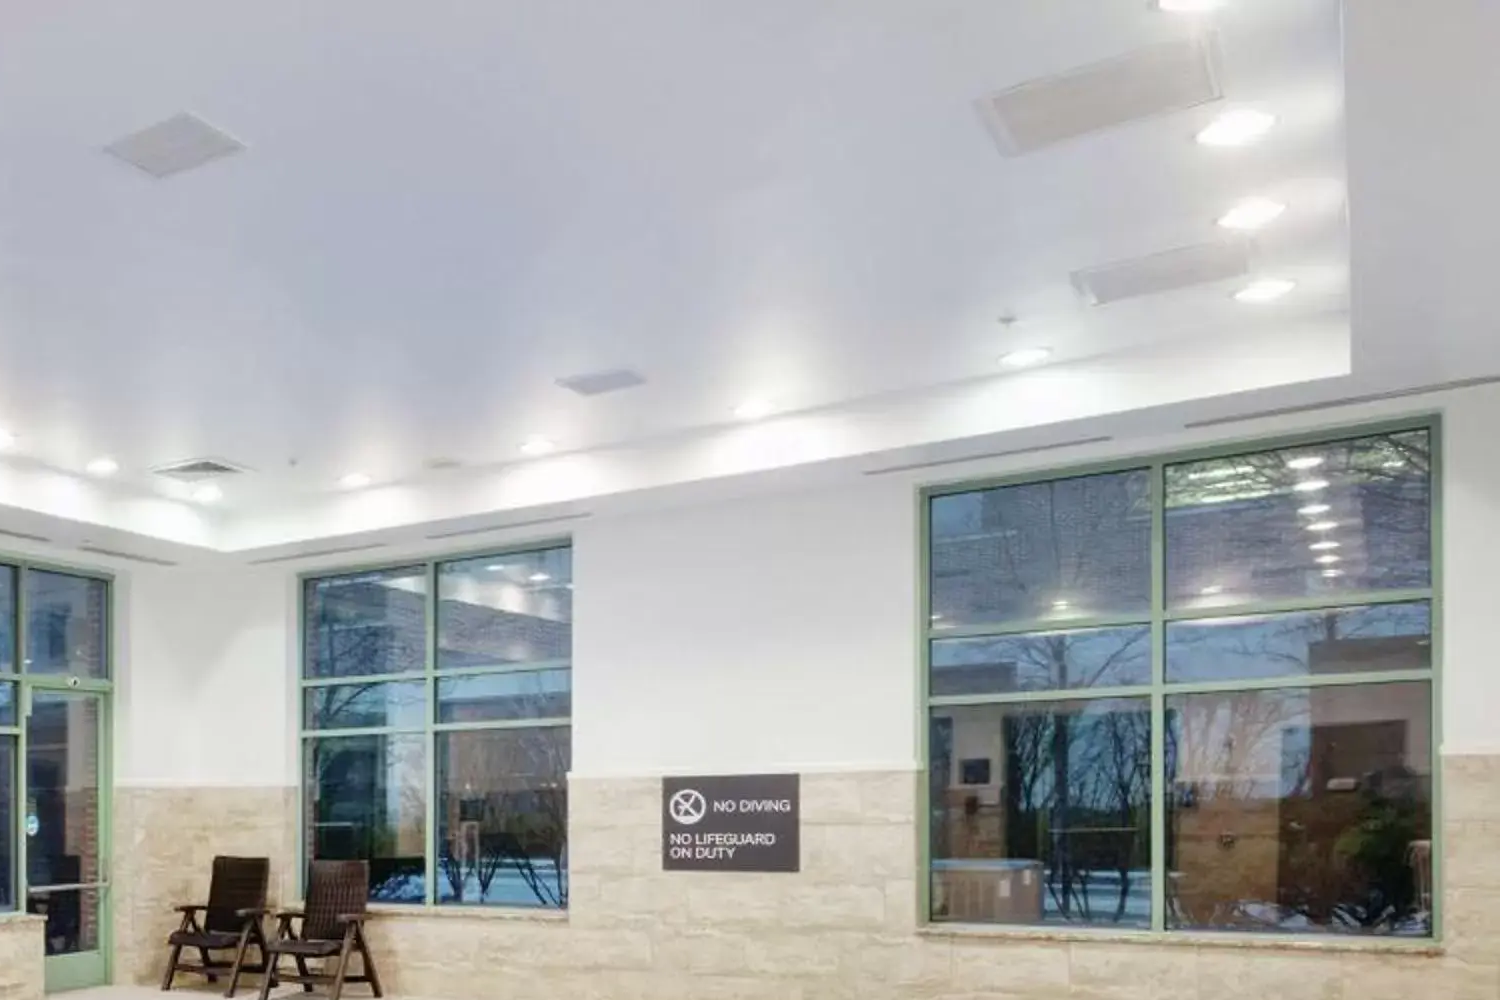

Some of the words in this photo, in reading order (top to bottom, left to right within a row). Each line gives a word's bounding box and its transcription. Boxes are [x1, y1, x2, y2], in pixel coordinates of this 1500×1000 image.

[713, 800, 736, 812] NO
[739, 799, 791, 812] DIVING
[669, 833, 693, 845] NO
[695, 832, 776, 846] LIFEGUARD
[669, 847, 692, 859] ON
[695, 847, 736, 859] DUTY
